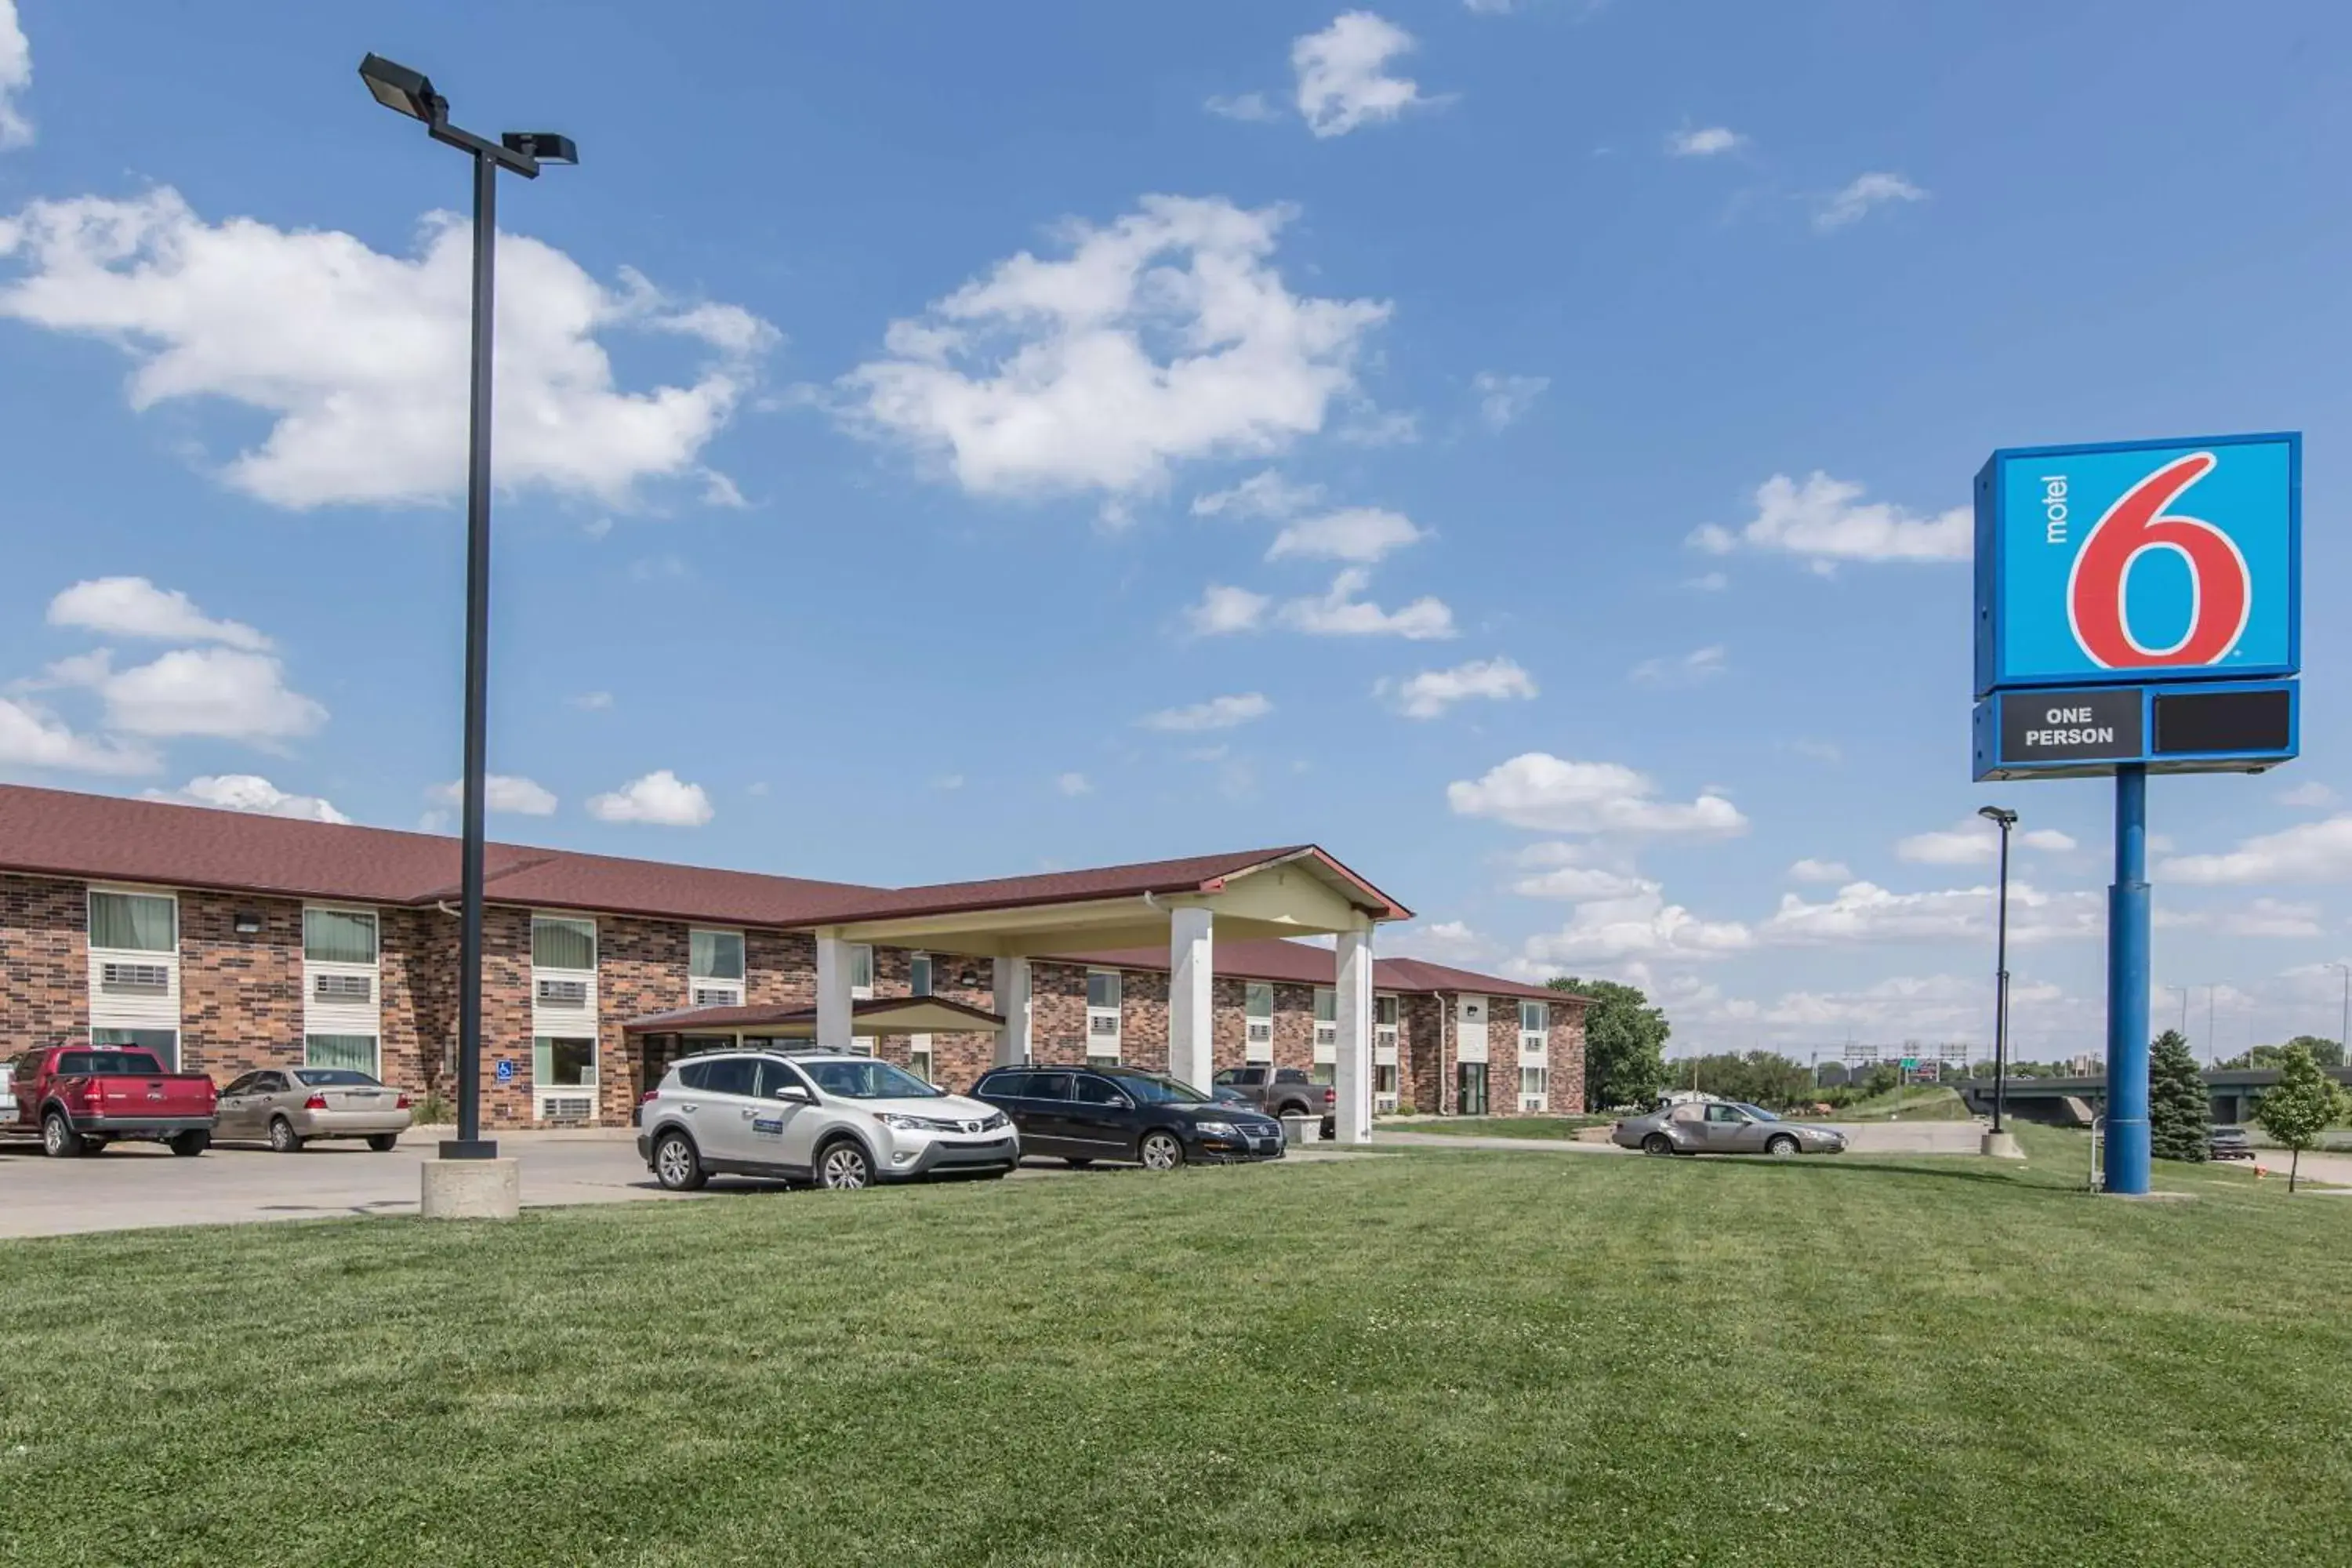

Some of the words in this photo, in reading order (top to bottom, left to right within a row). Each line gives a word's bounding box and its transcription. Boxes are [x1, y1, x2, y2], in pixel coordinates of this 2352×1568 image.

[2041, 476, 2067, 543] motel
[2067, 452, 2252, 669] 6
[2046, 707, 2092, 724] ONE
[2026, 727, 2114, 746] PERSON
